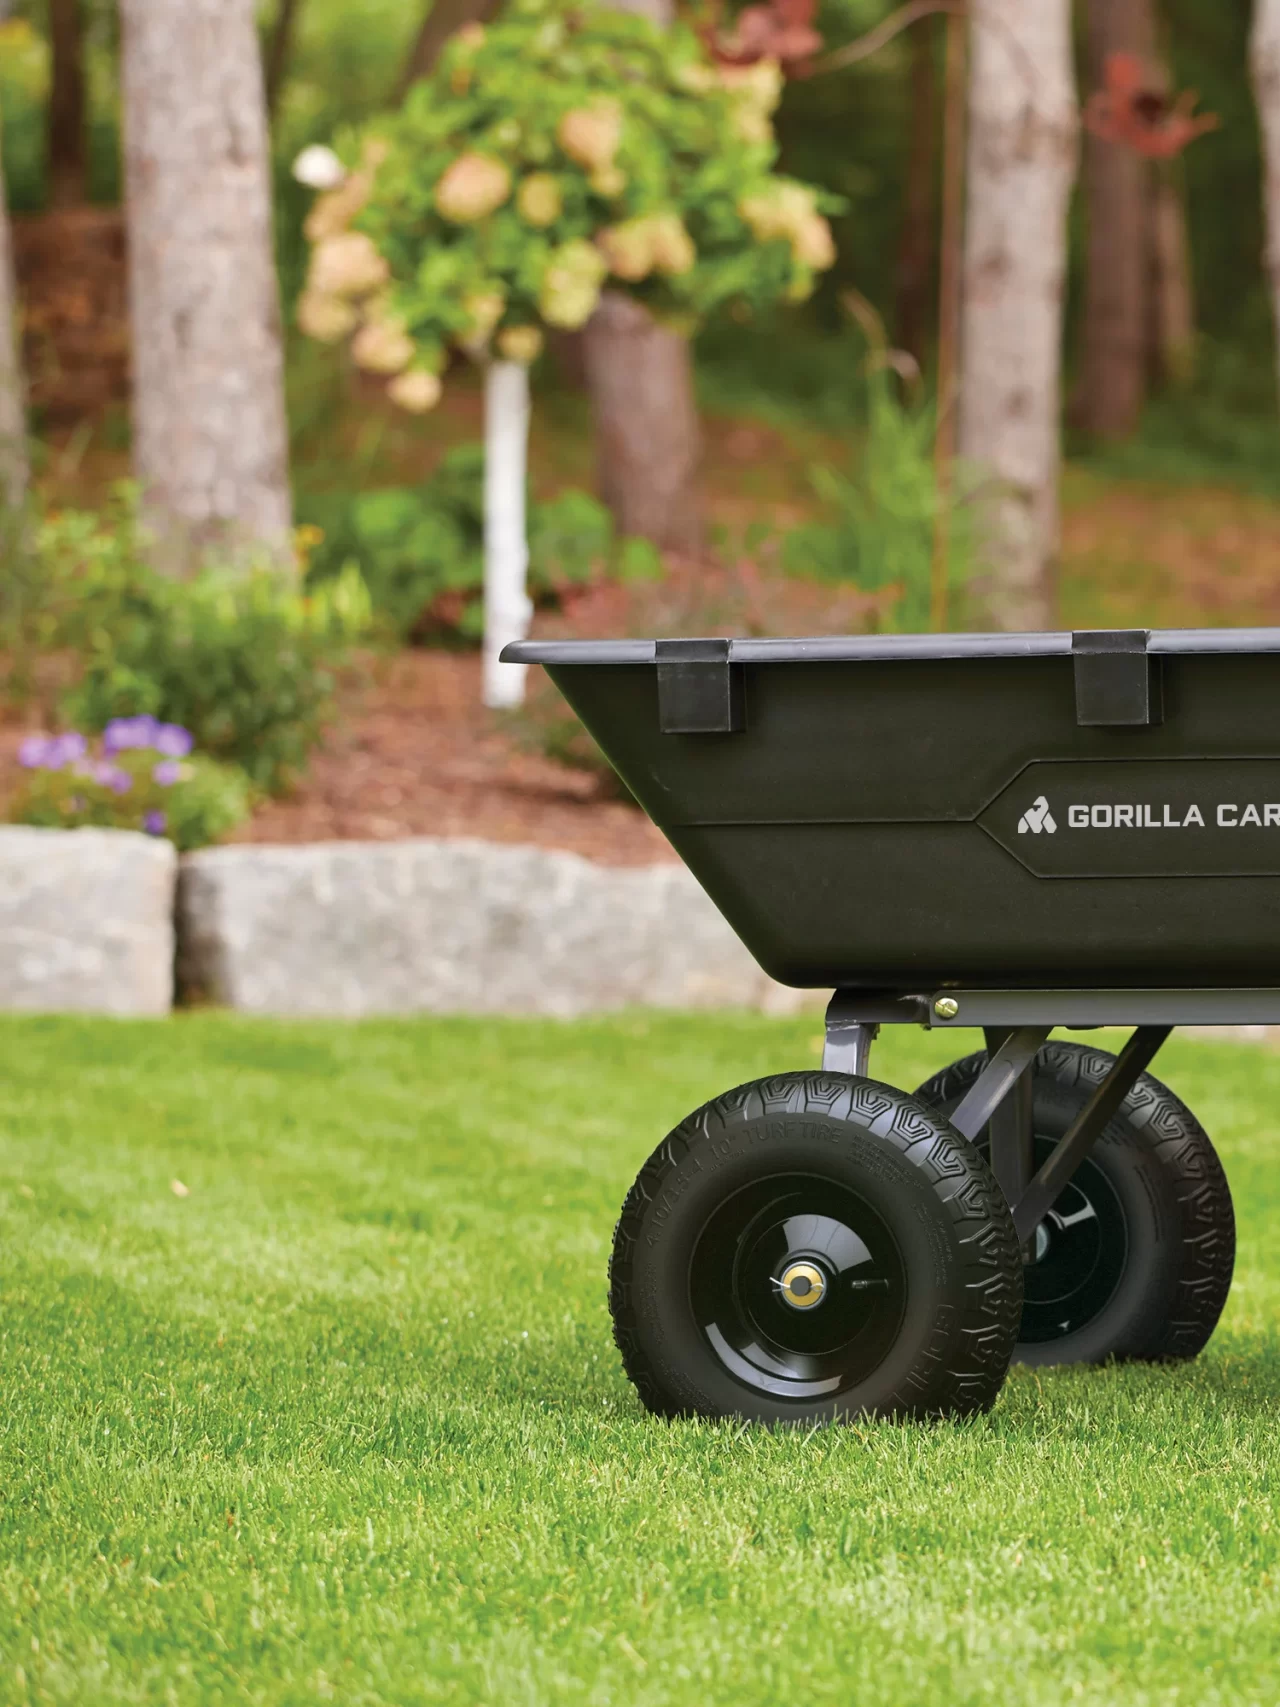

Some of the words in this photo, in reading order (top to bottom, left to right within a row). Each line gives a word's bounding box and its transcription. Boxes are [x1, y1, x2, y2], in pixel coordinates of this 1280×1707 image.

[1068, 804, 1205, 828] GORILLA
[742, 1120, 797, 1144] TURF
[797, 1120, 844, 1144] TIRE
